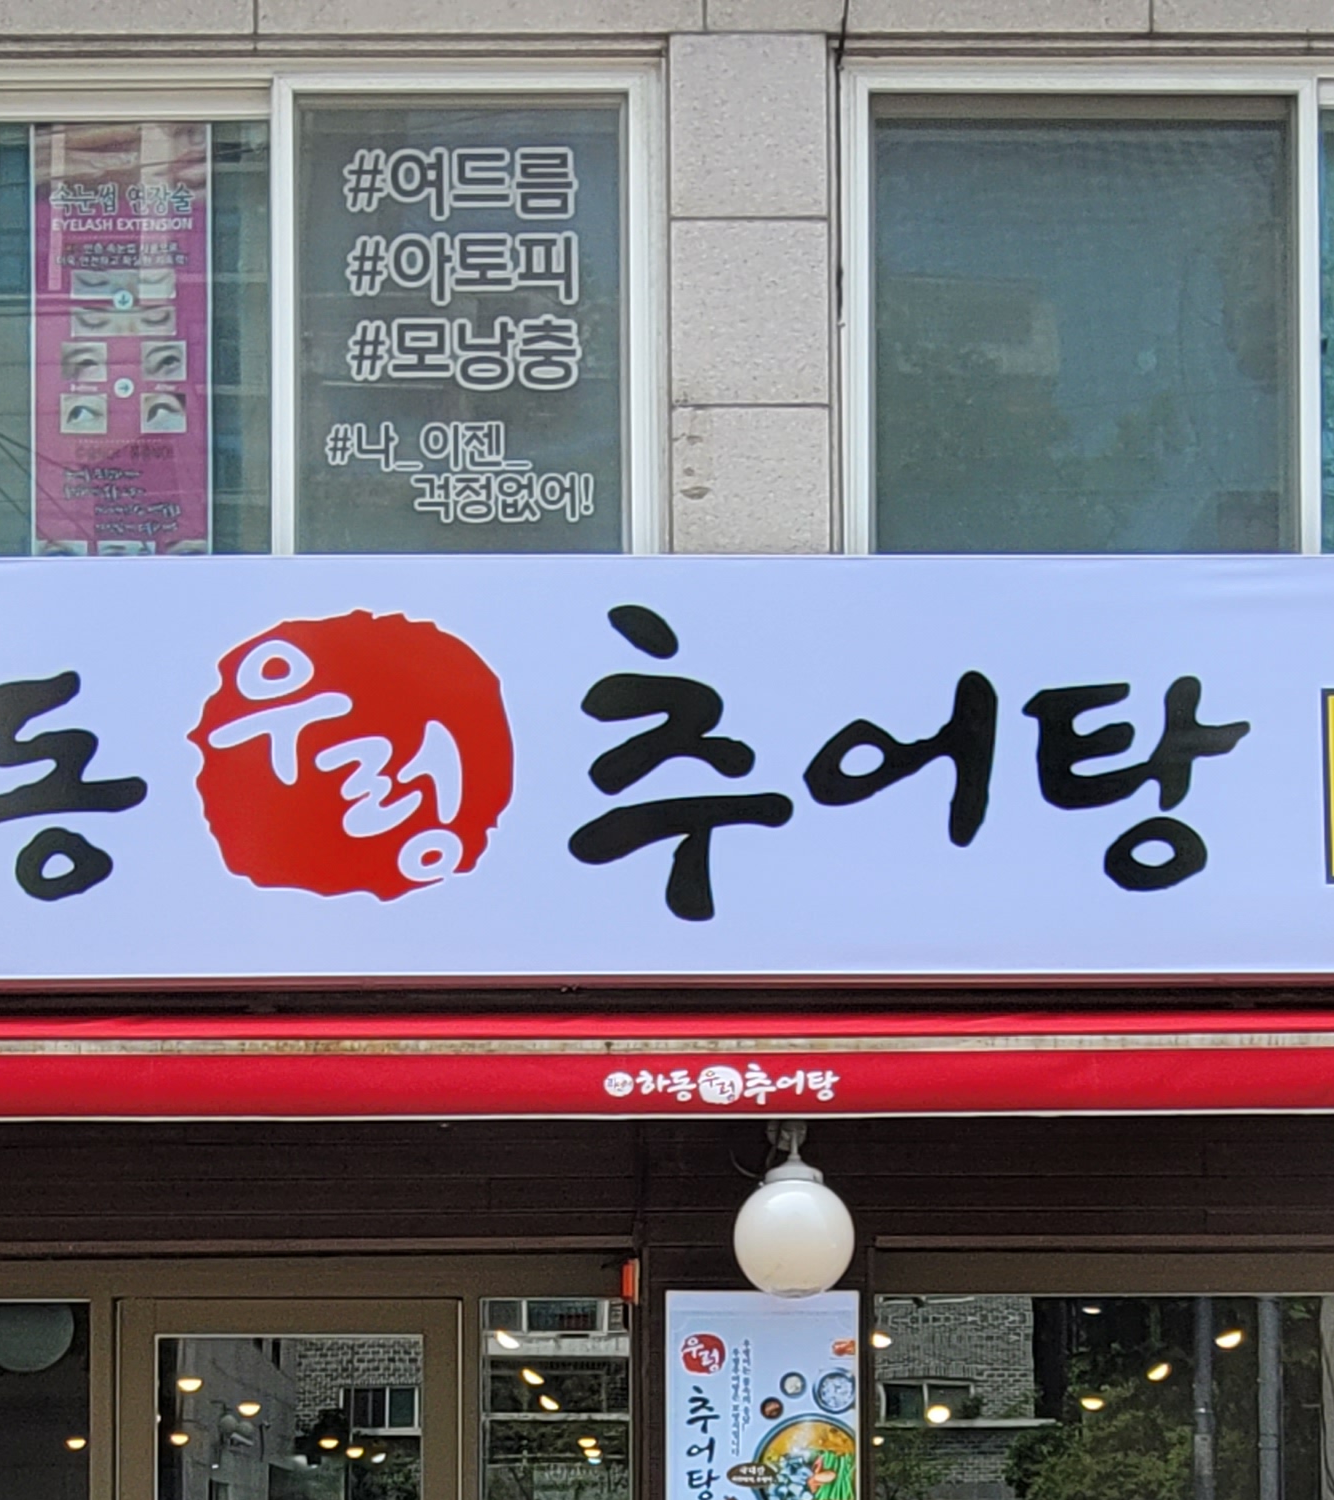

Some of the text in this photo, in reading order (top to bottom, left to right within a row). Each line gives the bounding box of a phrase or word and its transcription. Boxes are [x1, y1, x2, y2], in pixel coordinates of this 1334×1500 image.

[50, 182, 194, 216] 속눈썹 연장술
[343, 146, 578, 221] #여드름
[51, 217, 193, 231] EYELASH EXTENSION
[345, 231, 579, 306] #아토피
[348, 315, 581, 391] #모낭충
[411, 472, 594, 523] 걱정없어!
[208, 639, 464, 882] 우렁
[567, 604, 1251, 922] 추어탕
[636, 1069, 697, 1102] 하동
[743, 1063, 840, 1105] 추어탕
[682, 1337, 720, 1373] 우렁
